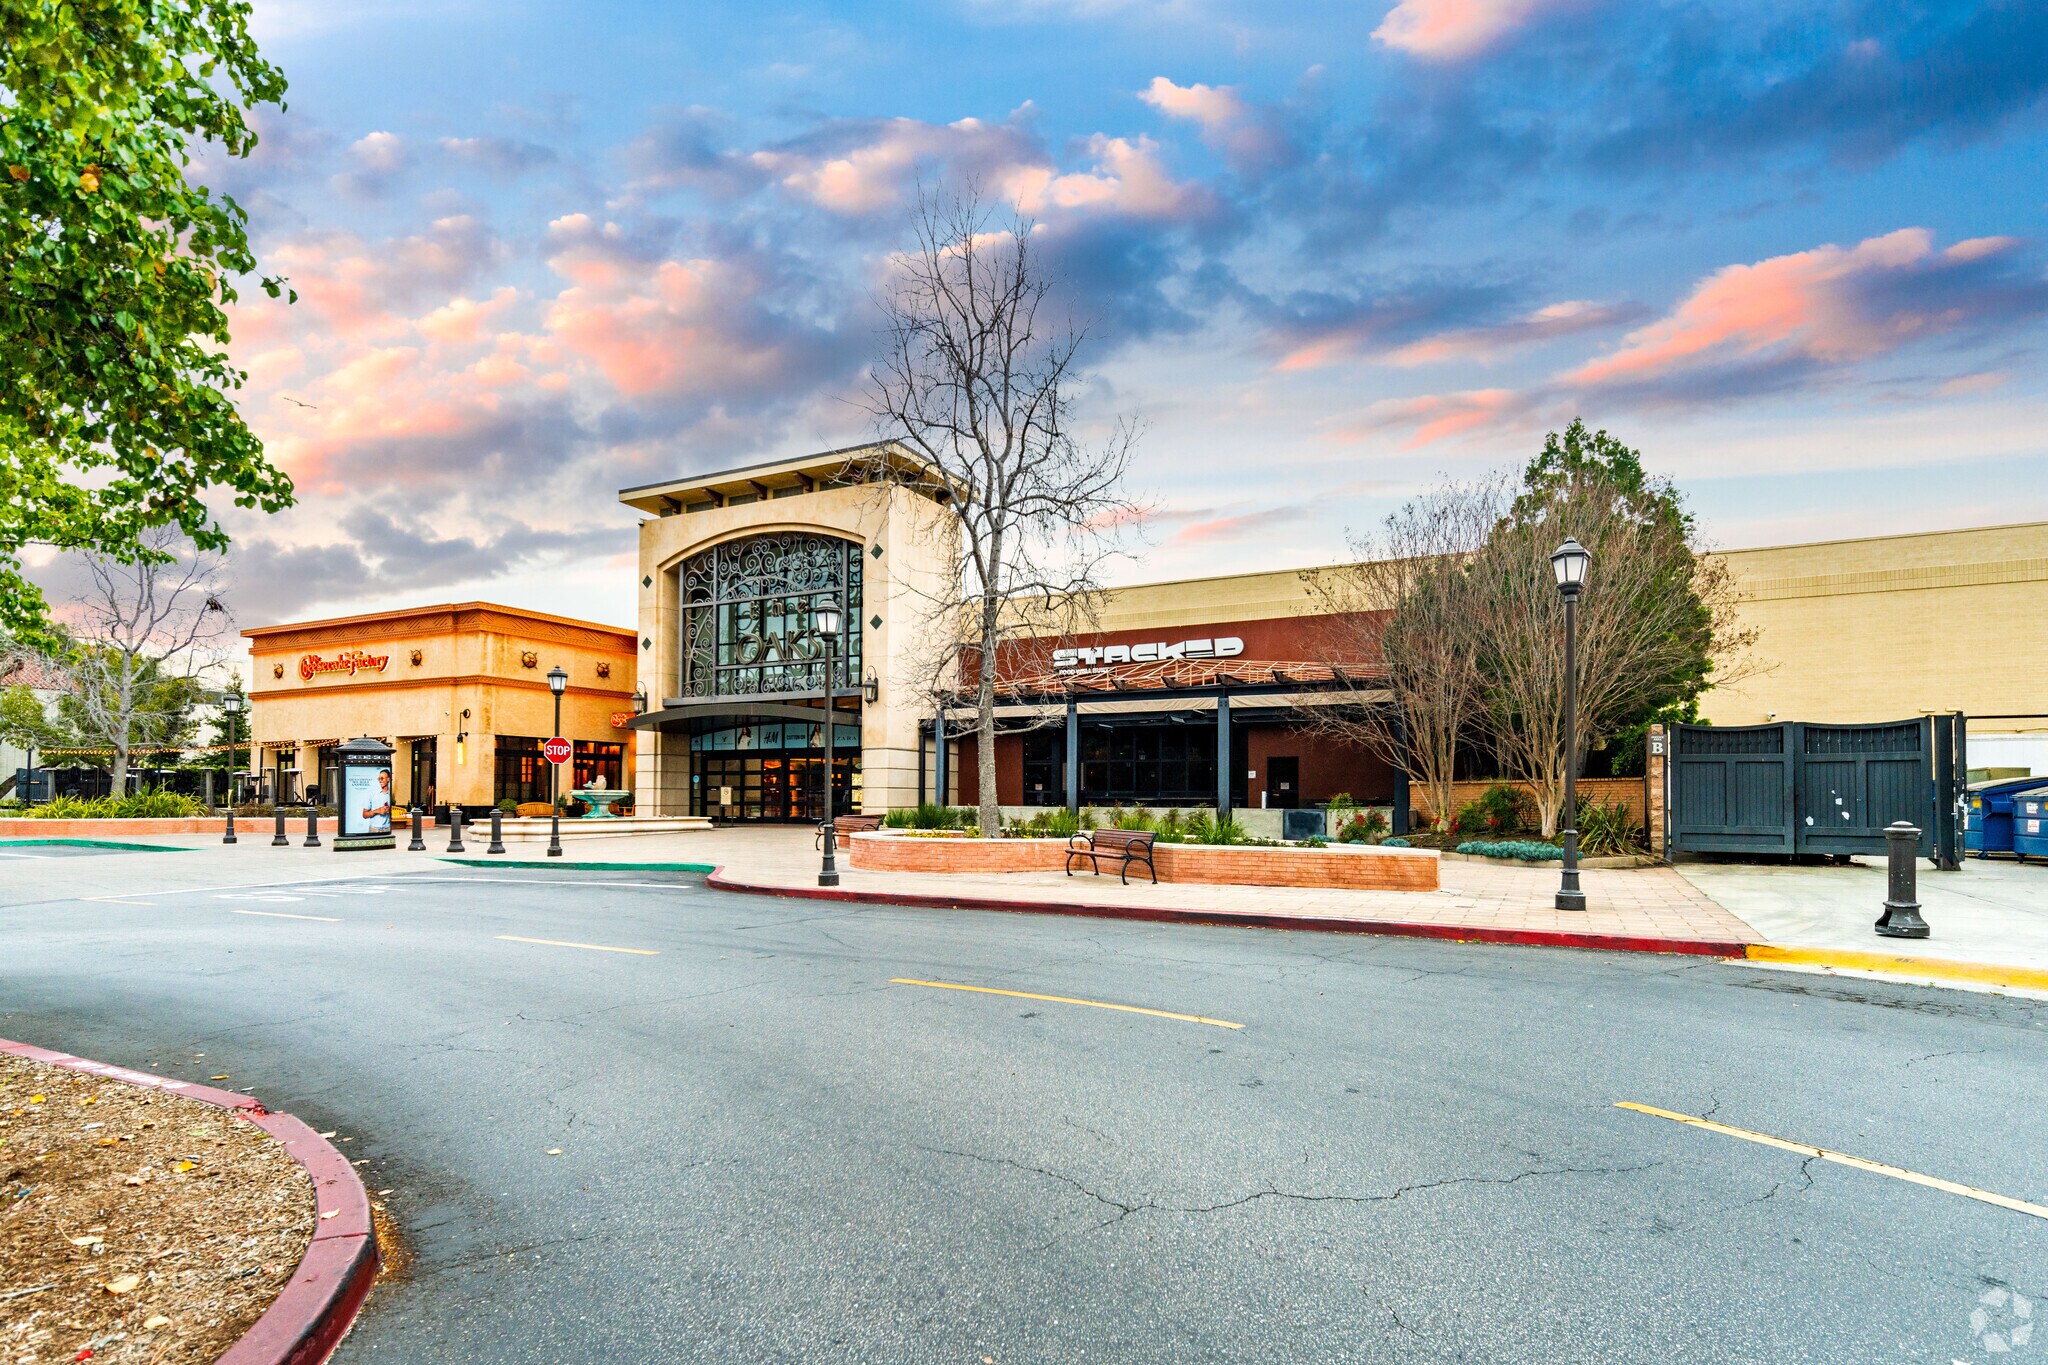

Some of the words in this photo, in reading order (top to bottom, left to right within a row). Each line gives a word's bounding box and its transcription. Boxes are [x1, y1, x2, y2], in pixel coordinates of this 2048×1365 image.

[736, 627, 820, 664] OAKS
[1052, 637, 1244, 667] STACKED
[345, 651, 389, 676] Factory
[546, 745, 570, 756] STOP
[1652, 742, 1663, 753] B
